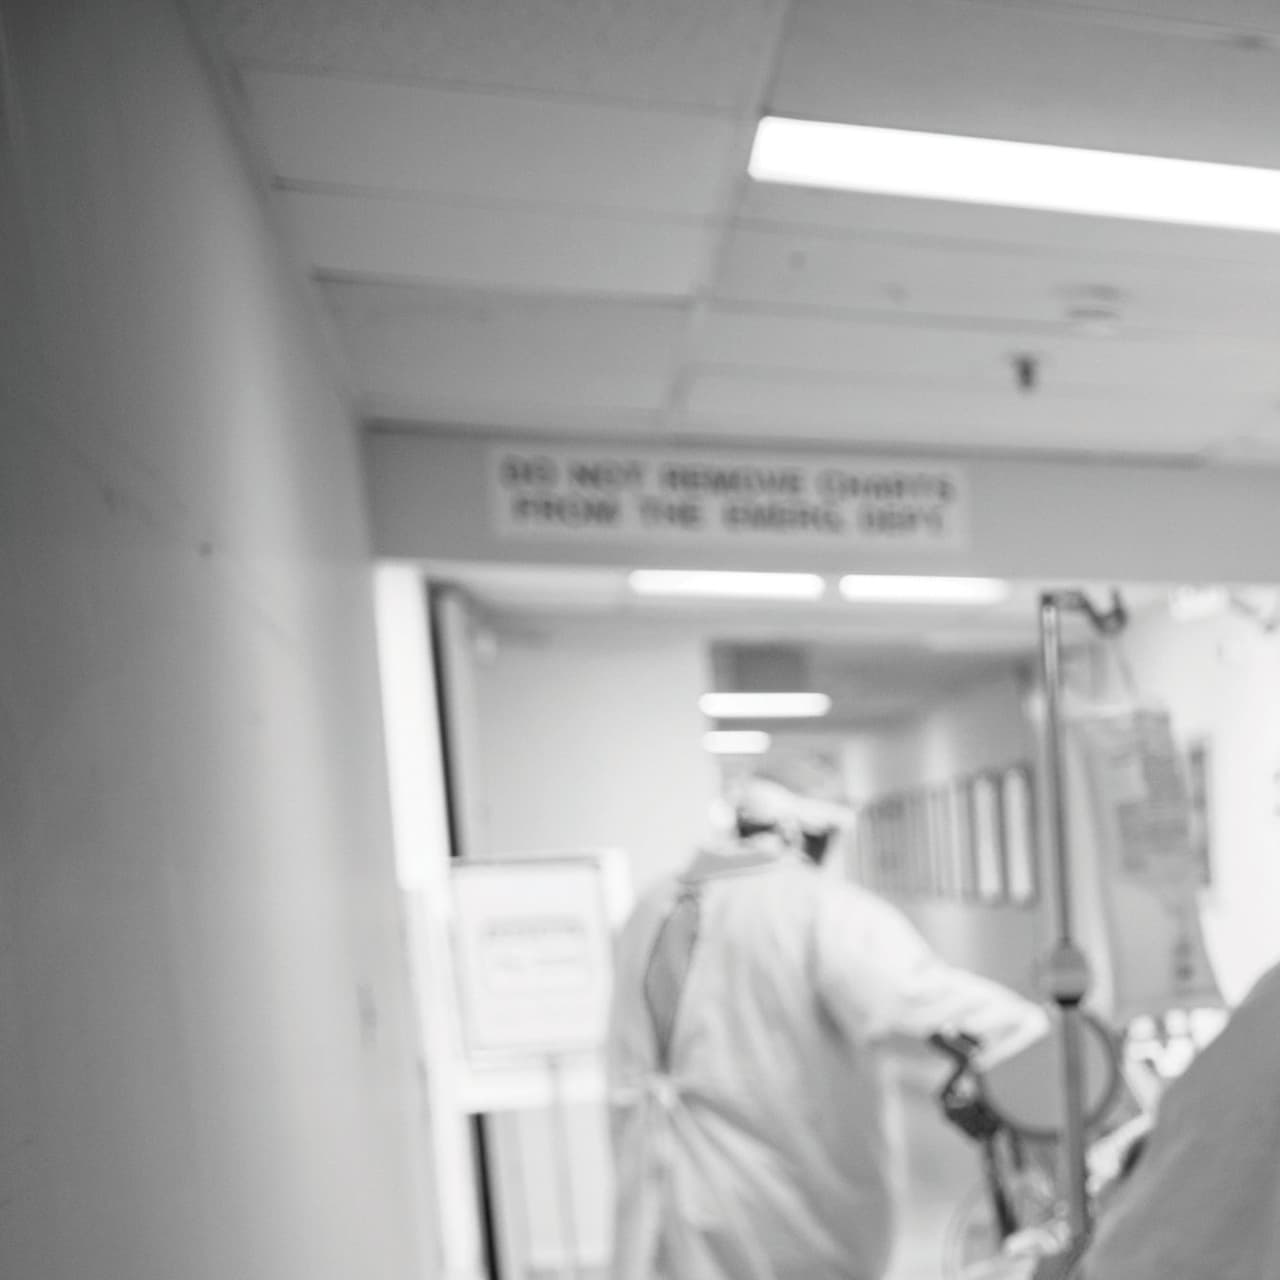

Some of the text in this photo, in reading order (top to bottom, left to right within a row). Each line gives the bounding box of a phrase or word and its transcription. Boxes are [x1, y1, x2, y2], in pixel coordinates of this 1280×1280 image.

[500, 455, 559, 488] DO
[567, 458, 644, 490] NOT
[656, 462, 806, 497] REMOVE
[510, 495, 621, 527] FROM
[637, 498, 703, 531] THE
